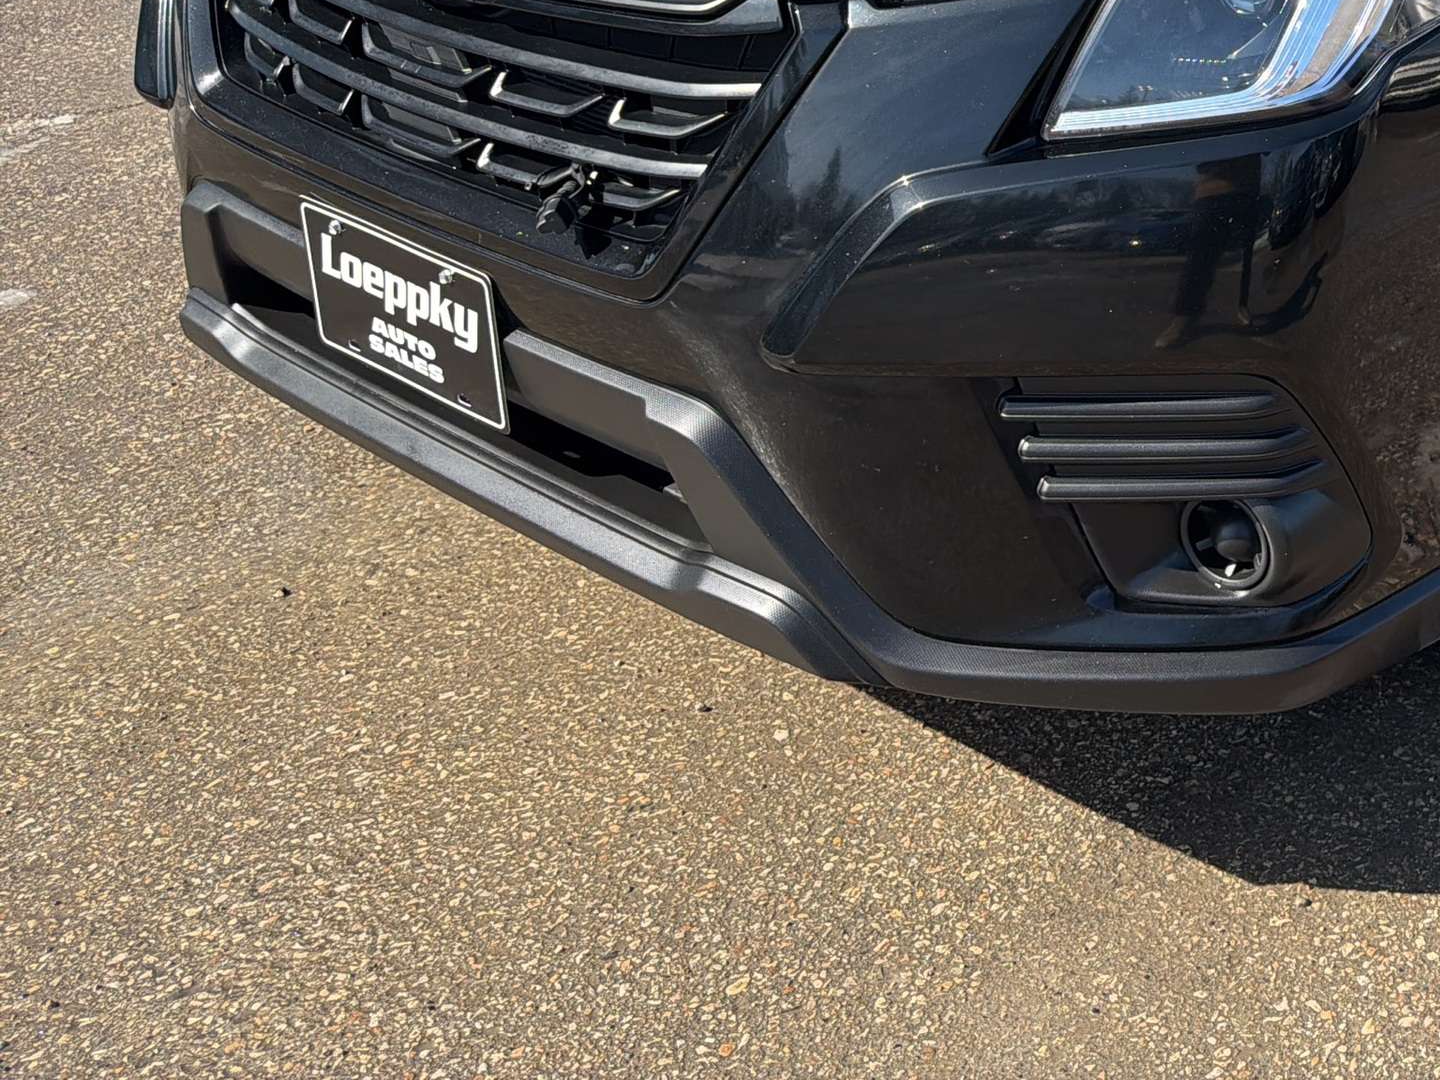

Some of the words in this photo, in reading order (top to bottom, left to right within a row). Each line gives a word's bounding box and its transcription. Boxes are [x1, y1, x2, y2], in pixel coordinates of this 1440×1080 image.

[320, 232, 479, 354] Loeppky
[368, 334, 445, 384] SALES
[371, 316, 436, 360] AUTO
